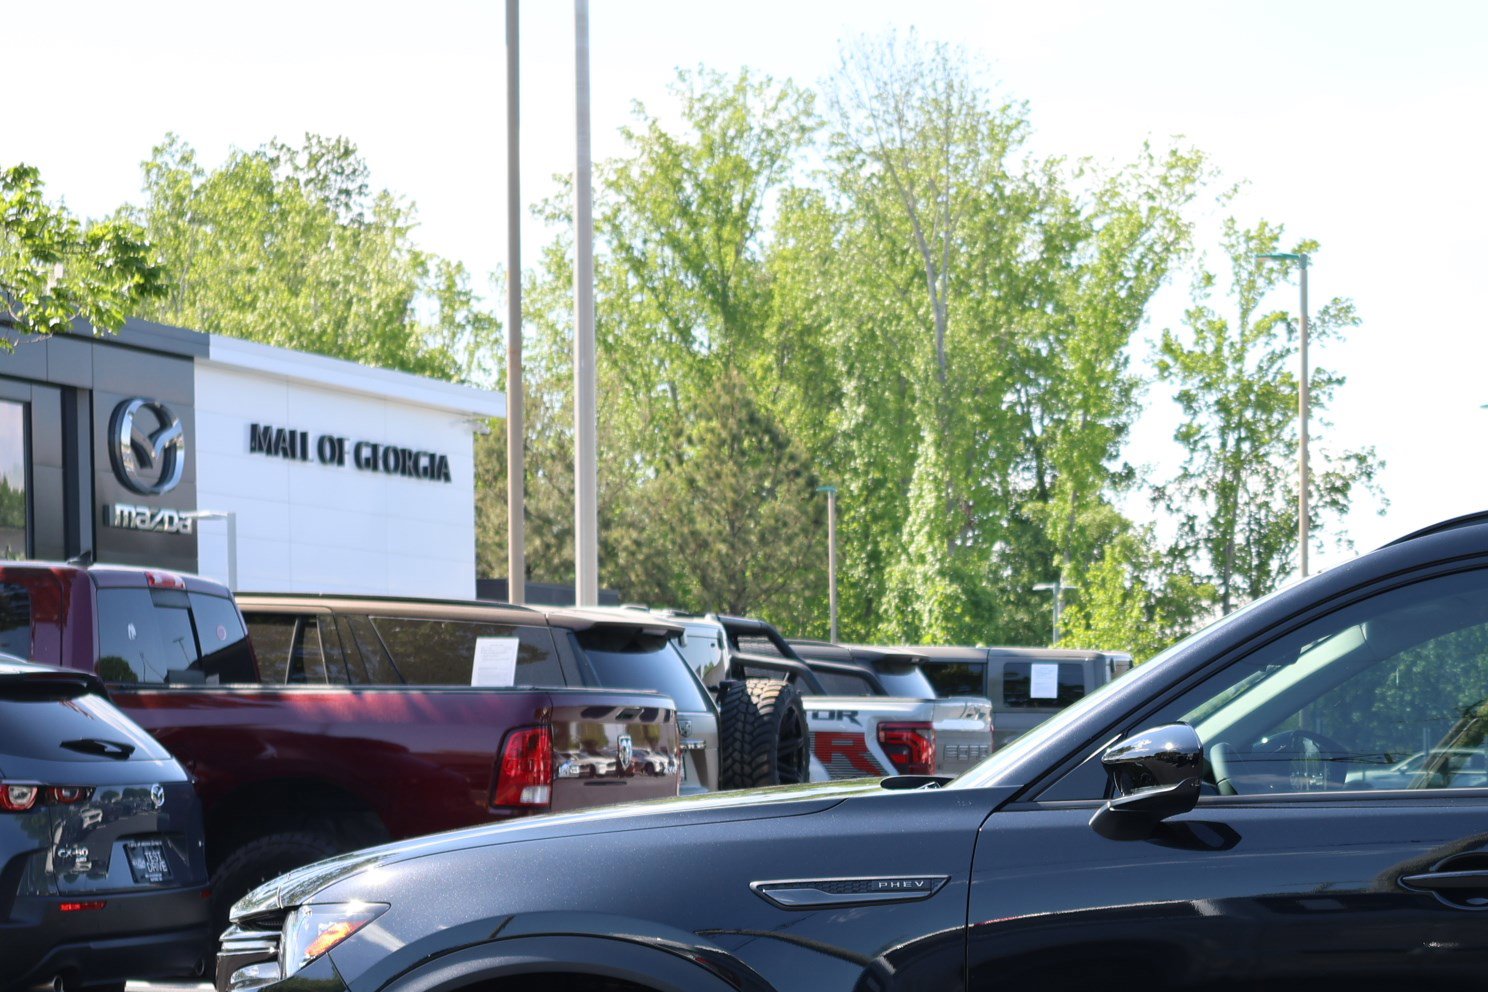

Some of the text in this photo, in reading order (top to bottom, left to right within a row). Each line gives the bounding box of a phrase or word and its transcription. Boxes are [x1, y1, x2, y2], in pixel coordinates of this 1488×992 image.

[250, 423, 452, 484] MALL OF GEORGIA
[114, 503, 193, 535] mazda
[144, 850, 162, 862] TEST
[878, 880, 924, 888] PHEV
